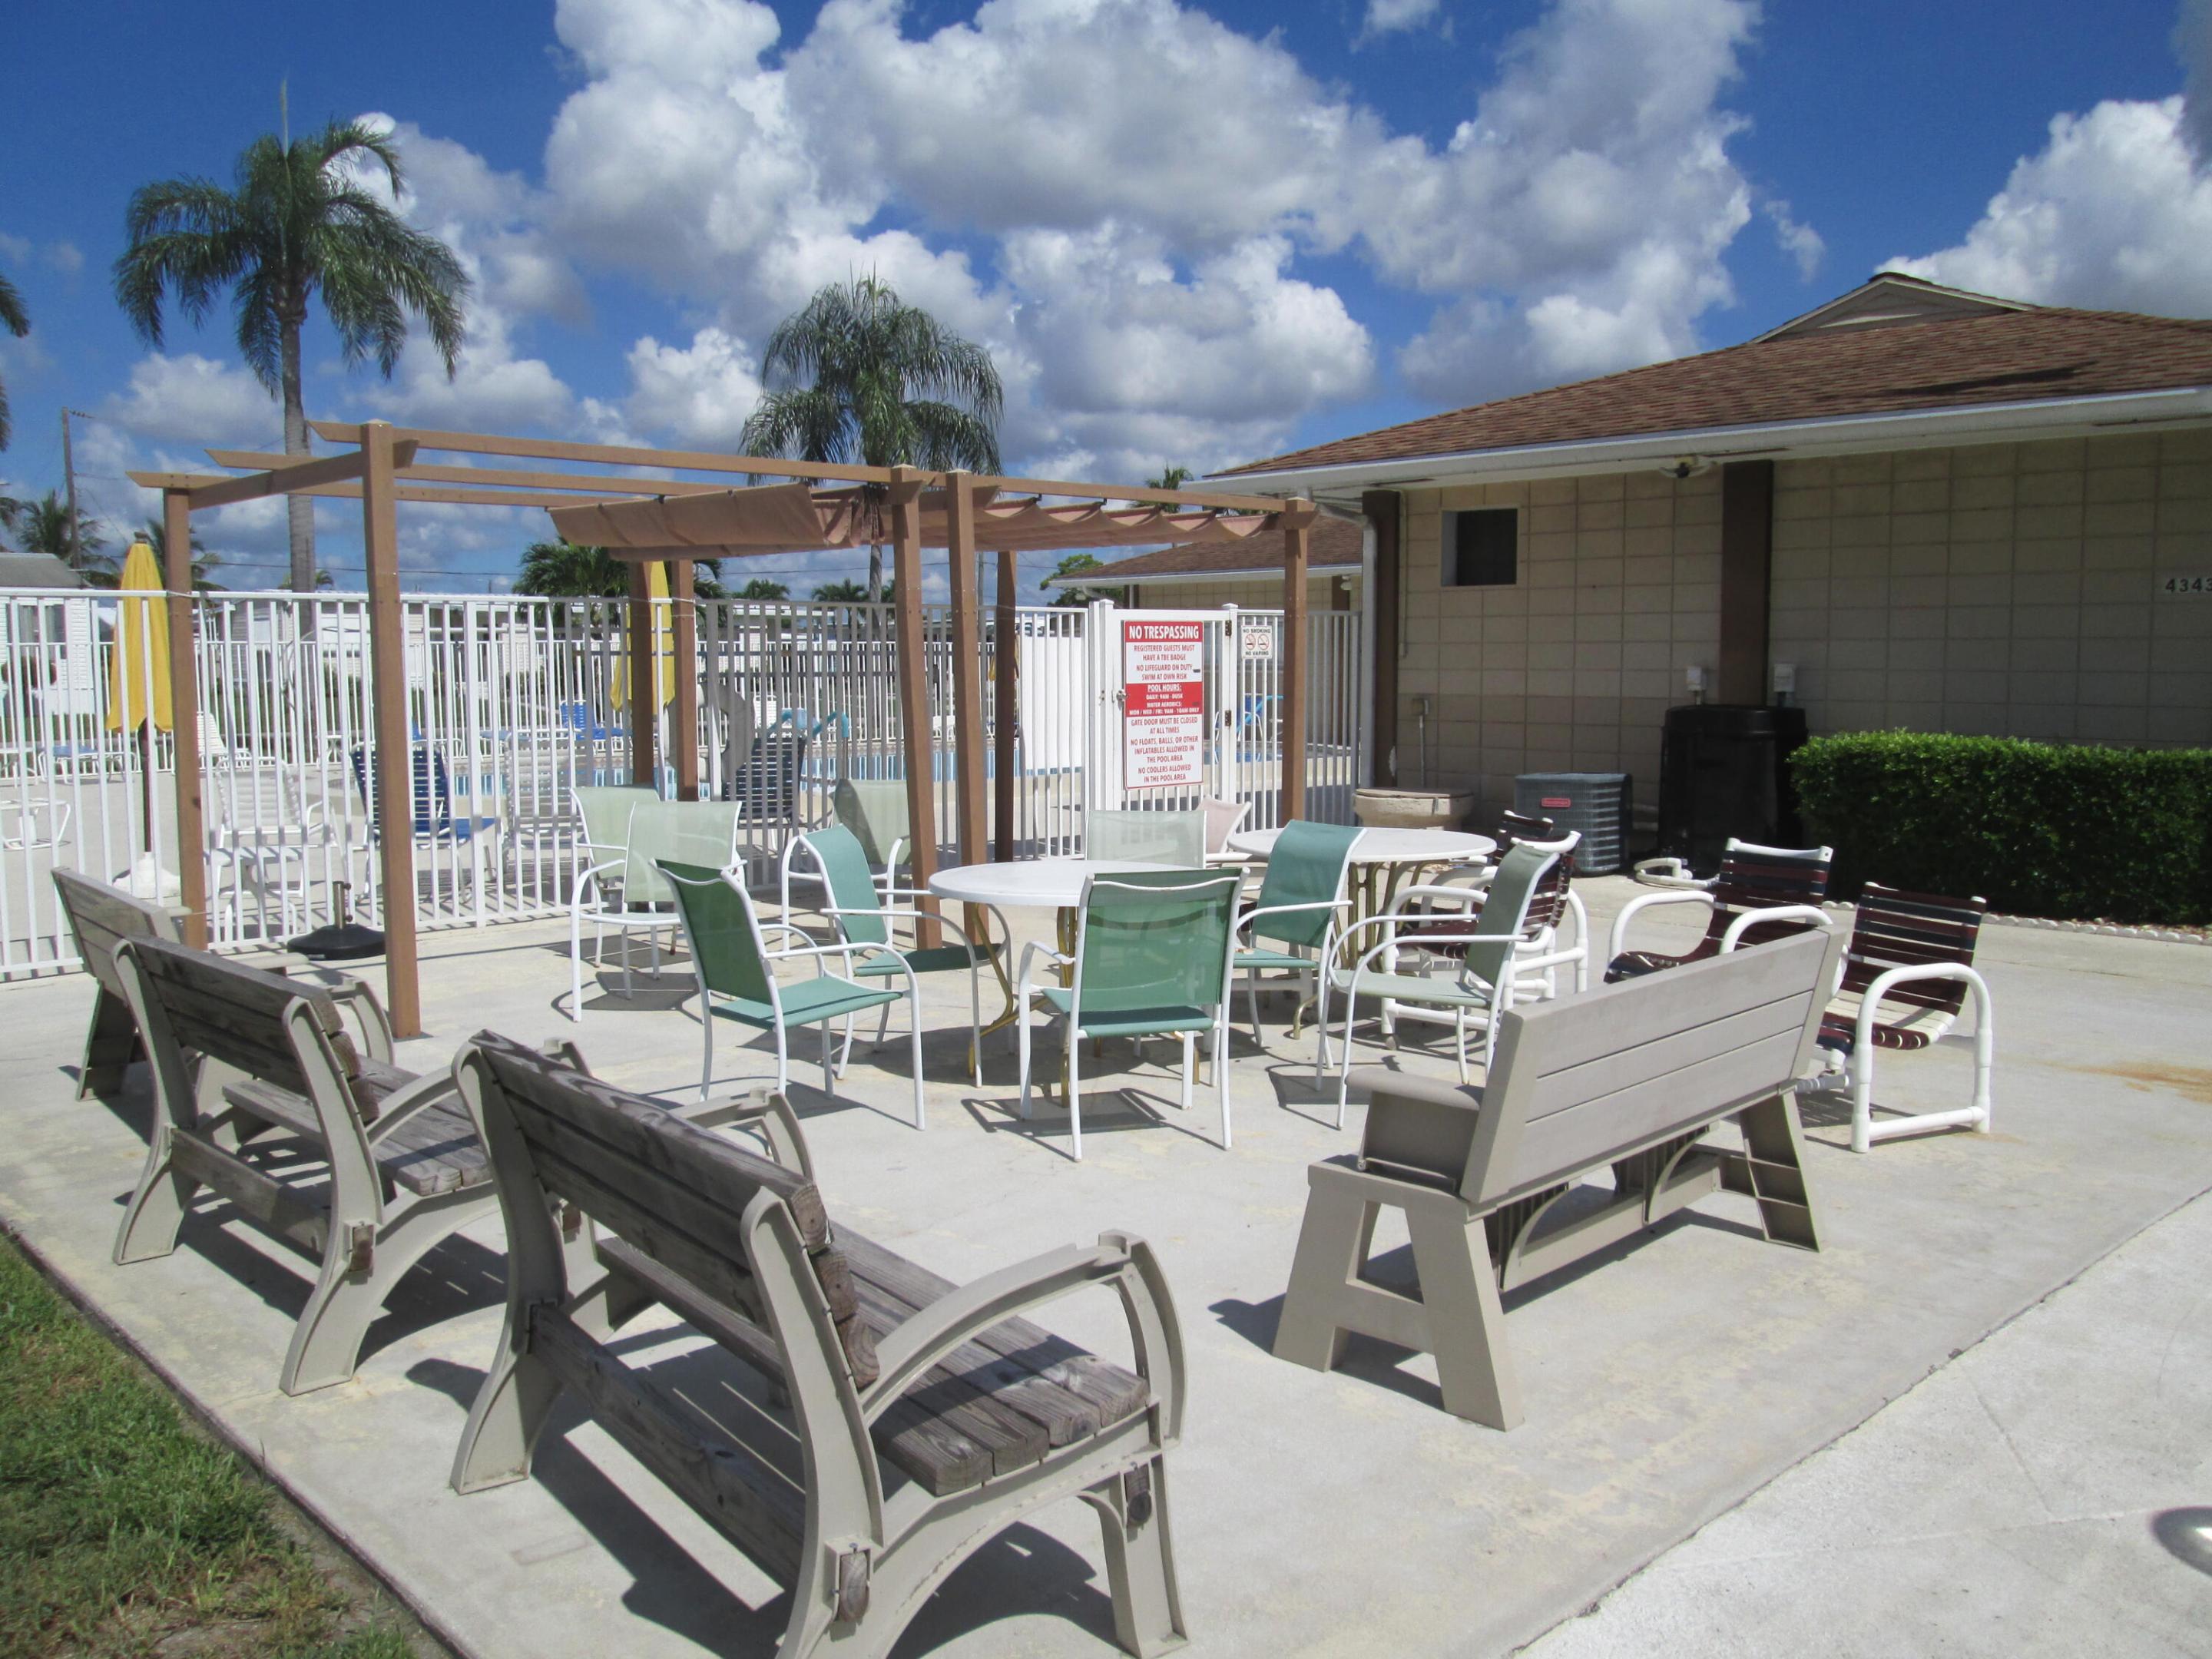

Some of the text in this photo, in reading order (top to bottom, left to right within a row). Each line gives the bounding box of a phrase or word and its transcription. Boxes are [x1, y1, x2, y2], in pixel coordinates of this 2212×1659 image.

[2165, 578, 2212, 593] 4343
[1129, 625, 1199, 639] NO TRESPASSING
[1134, 747, 1165, 755] INFLATABLES
